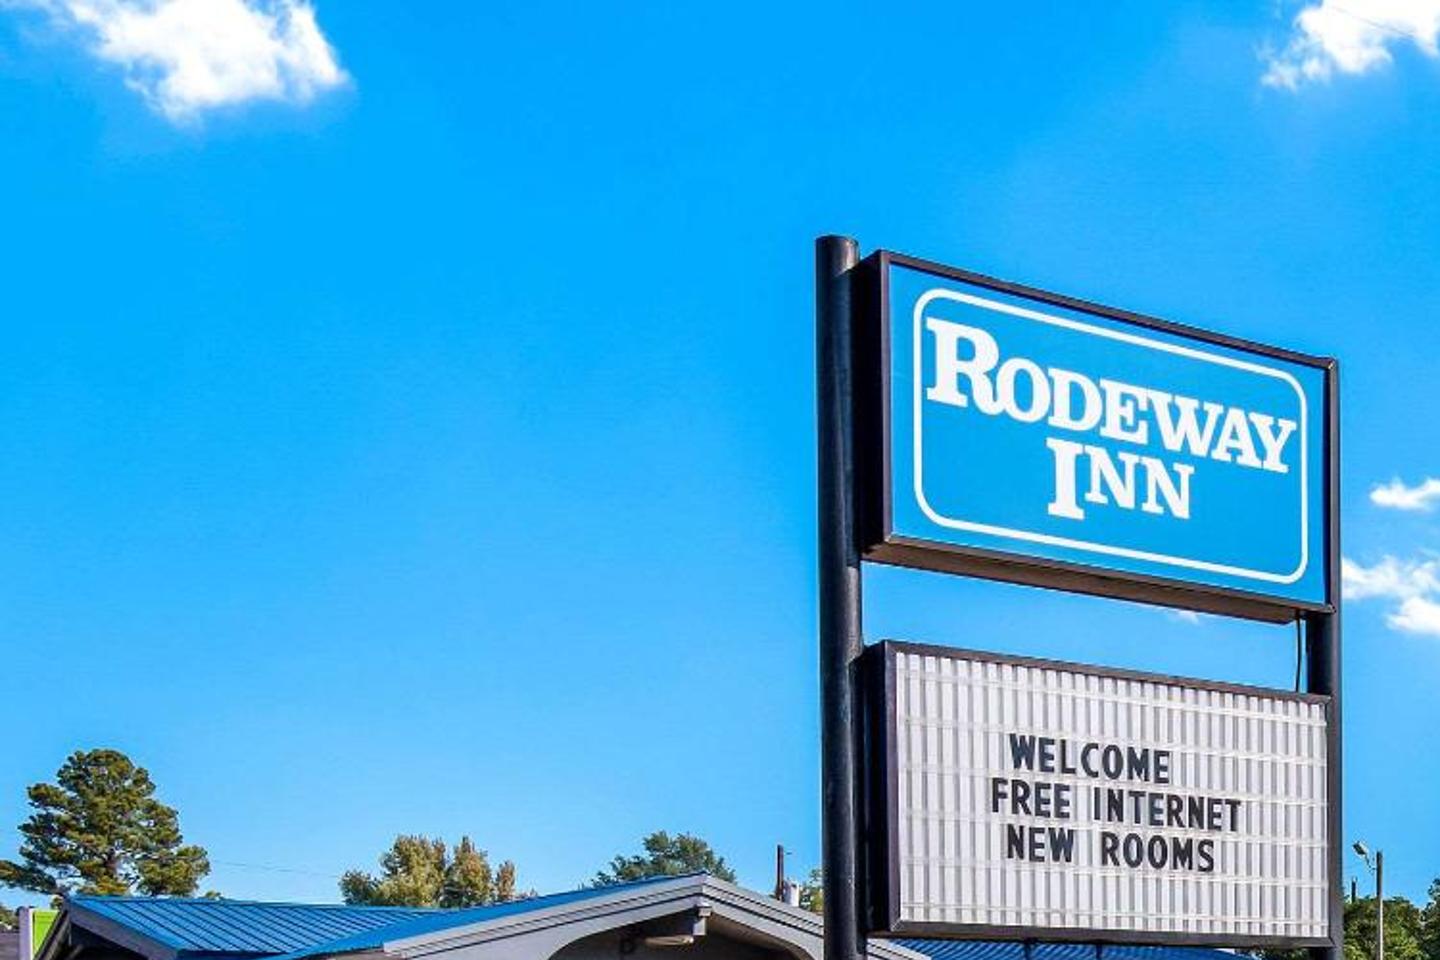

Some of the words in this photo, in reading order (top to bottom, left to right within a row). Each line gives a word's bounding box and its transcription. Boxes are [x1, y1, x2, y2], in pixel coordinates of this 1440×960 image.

[926, 317, 1297, 473] RODEWAY
[1046, 437, 1195, 519] INN
[1009, 733, 1169, 784] WELCOME
[991, 777, 1070, 818] FREE
[1093, 788, 1241, 832] INTERNET
[1006, 825, 1074, 863] NEW
[1101, 832, 1214, 872] ROOMS
